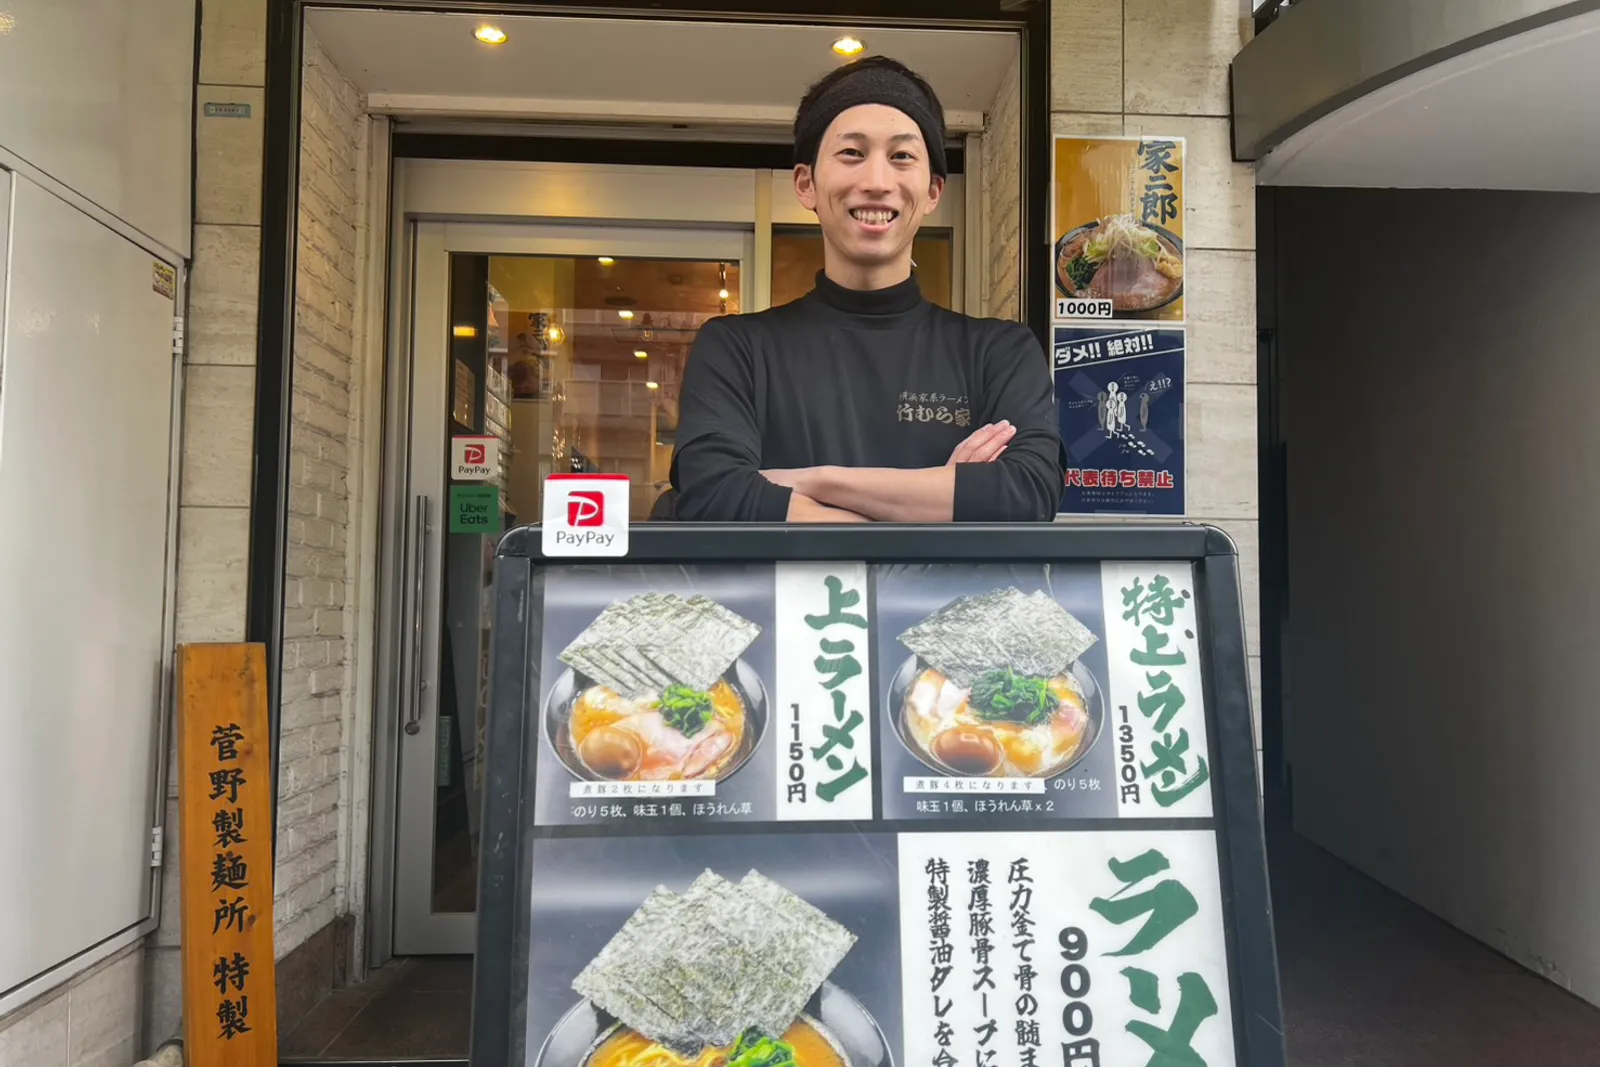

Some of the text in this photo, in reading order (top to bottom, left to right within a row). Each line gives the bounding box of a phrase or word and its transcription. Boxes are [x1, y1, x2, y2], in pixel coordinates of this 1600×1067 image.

[1137, 140, 1179, 225] 家二郎
[1058, 302, 1112, 316] 1000円
[1107, 334, 1154, 357] 絶対!!
[458, 466, 491, 475] PayPay
[1065, 468, 1174, 489] 代表待ち禁止
[460, 503, 488, 513] Uber
[460, 514, 488, 525] Eats
[556, 531, 615, 547] PayPay
[803, 574, 869, 804] 上ラーメン
[787, 704, 807, 804] 1150円
[1118, 705, 1141, 804] 1350円
[967, 858, 999, 1067] 濃厚豚骨スープに
[1008, 857, 1042, 1067] 圧力釜で骨の髄ま
[1058, 926, 1101, 1067] 900円
